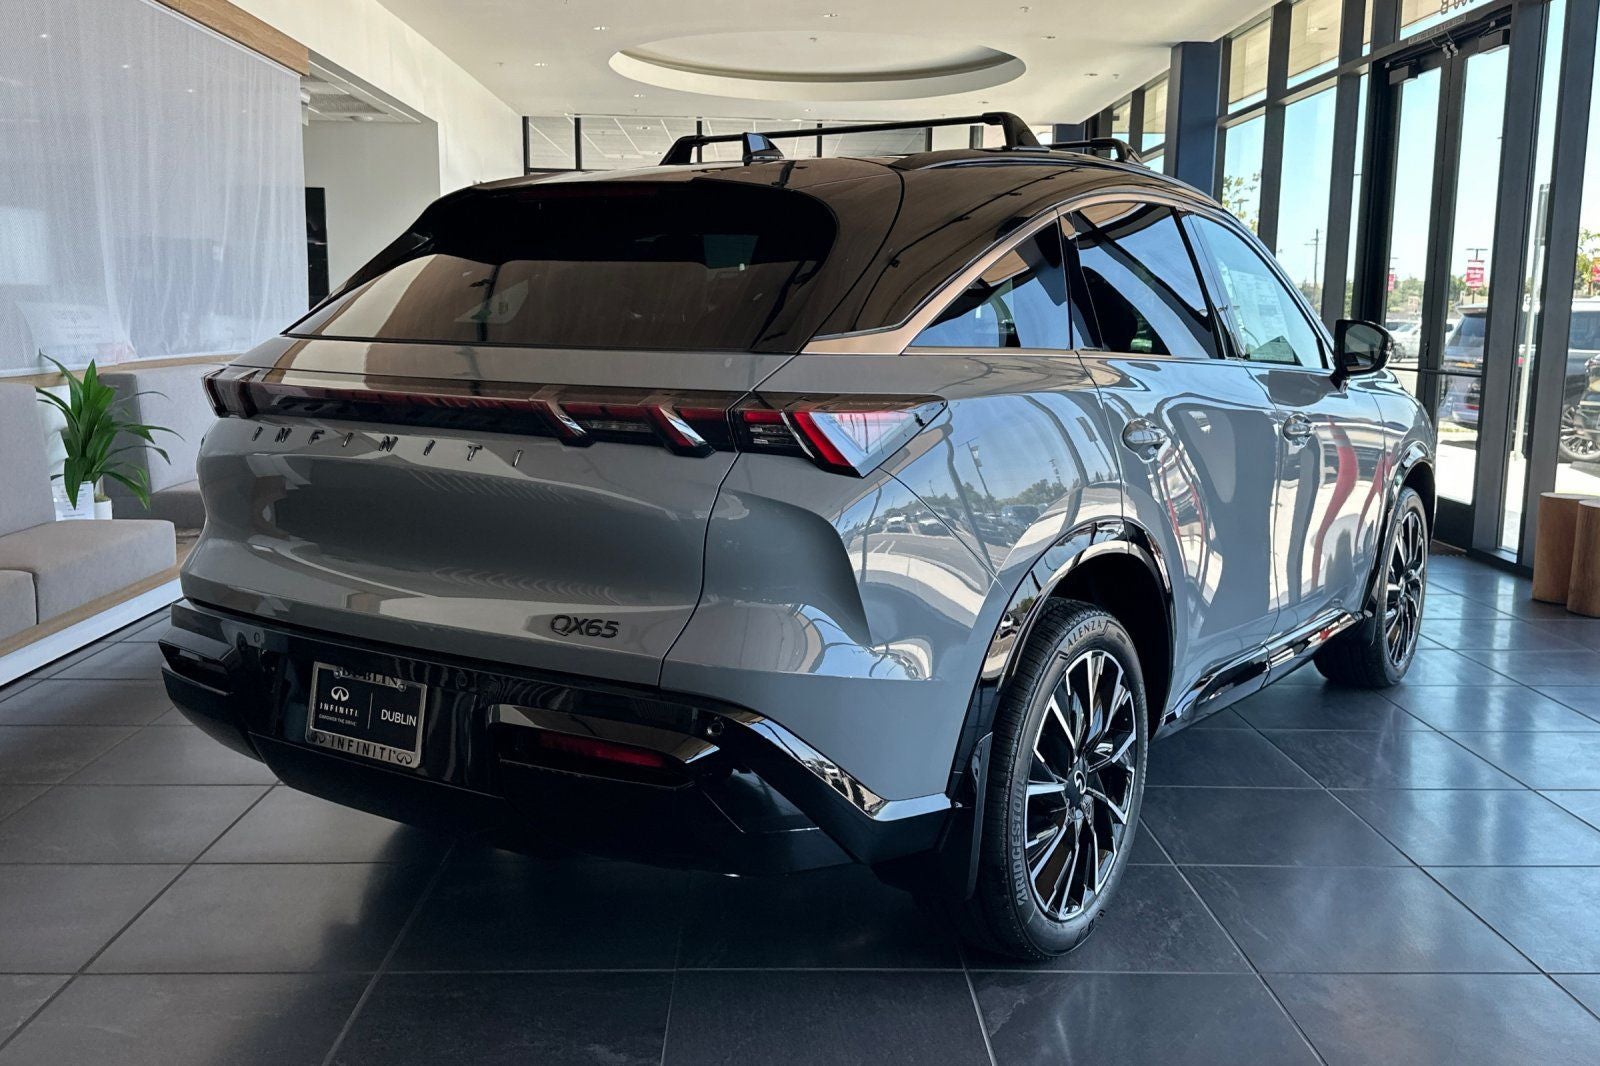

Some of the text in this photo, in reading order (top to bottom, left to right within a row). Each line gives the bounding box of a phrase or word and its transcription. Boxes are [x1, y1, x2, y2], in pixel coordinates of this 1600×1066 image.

[252, 426, 524, 468] INFINITI
[550, 614, 620, 639] QX65
[1066, 620, 1103, 647] ALENZA
[319, 702, 359, 717] INFINITI
[380, 709, 417, 727] DUBLIN
[331, 734, 392, 761] INFINITI
